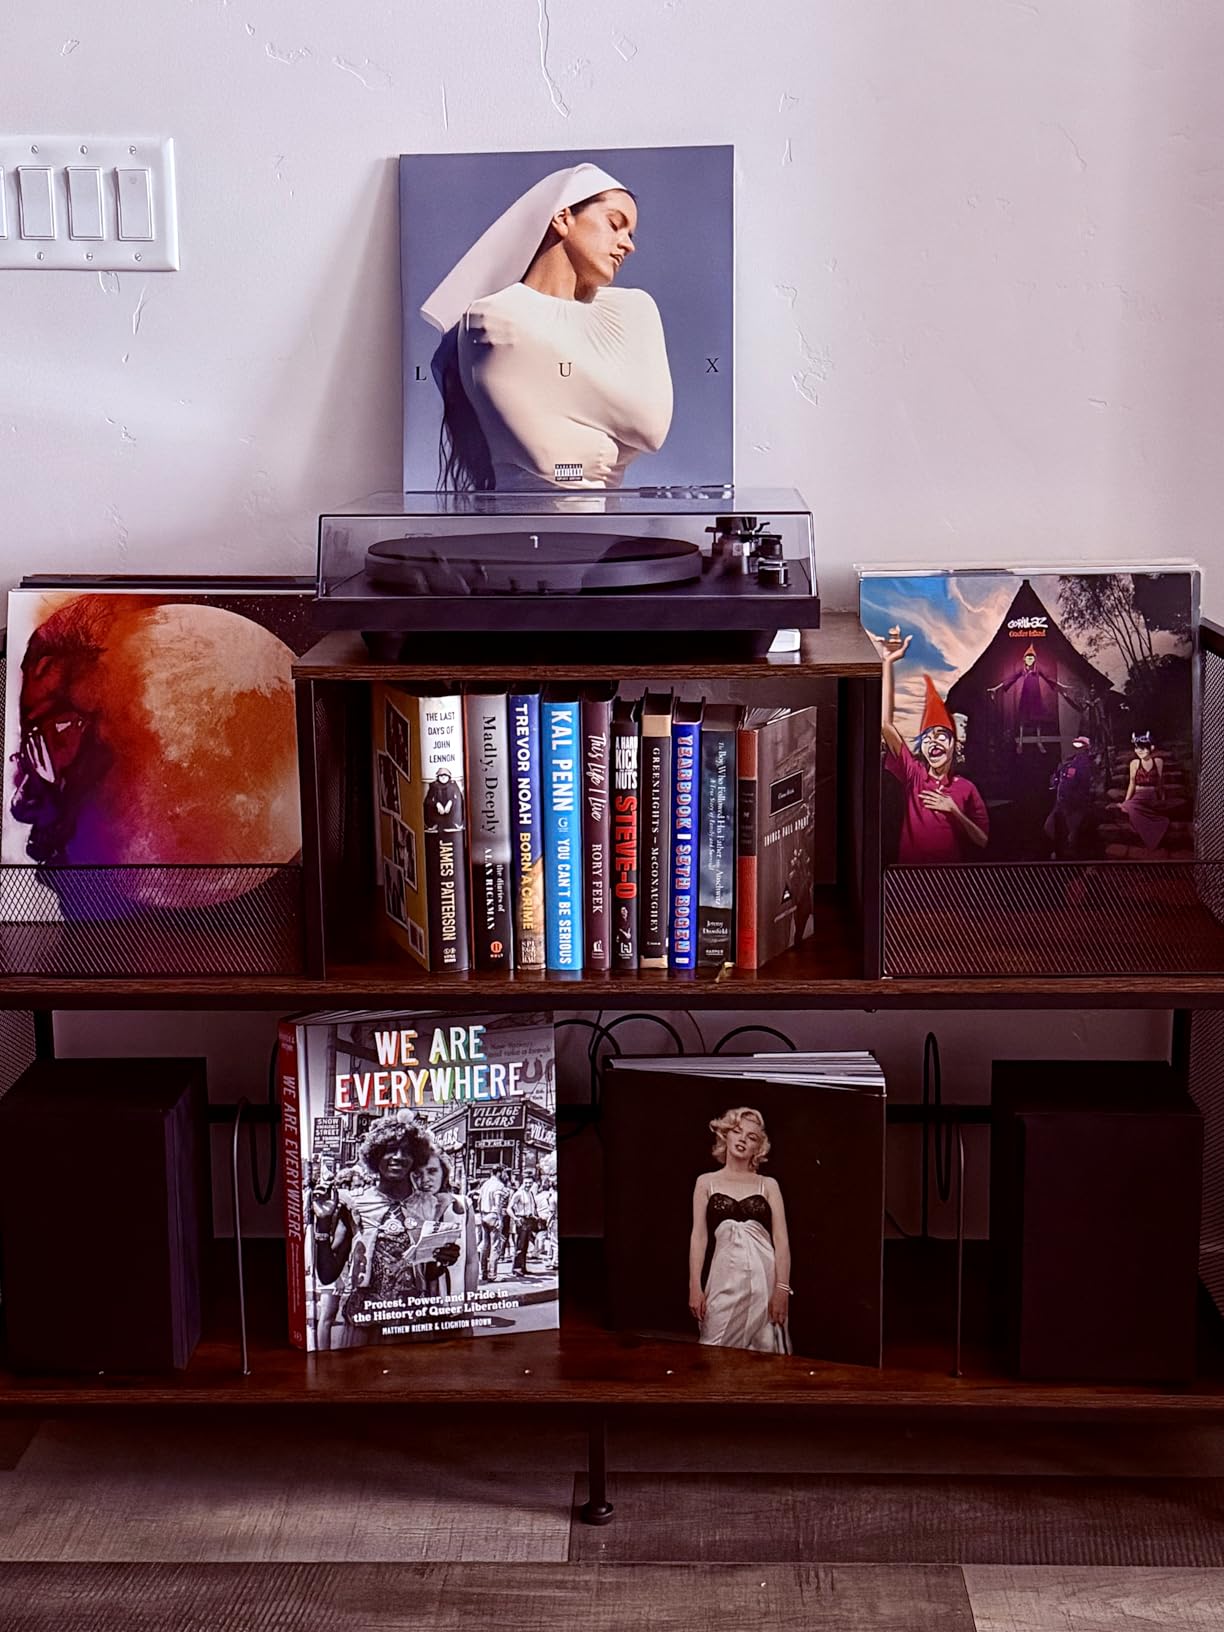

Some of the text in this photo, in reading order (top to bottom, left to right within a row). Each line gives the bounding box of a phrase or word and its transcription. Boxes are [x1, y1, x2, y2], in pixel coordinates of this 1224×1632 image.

[415, 358, 720, 381] L U X
[426, 711, 455, 721] THE LAST
[427, 725, 455, 736] DAYS OF
[551, 710, 573, 751] KAL
[429, 753, 455, 763] LENNON
[433, 740, 451, 750] JOHN
[587, 732, 607, 761] This
[615, 750, 638, 769] KICK
[480, 716, 500, 834] Madly, Deeply
[515, 703, 532, 825] TREVOR NOAH
[586, 762, 607, 786] Life
[552, 759, 574, 811] PENN
[615, 772, 638, 790] NUTS
[651, 747, 661, 833] GREENLIGHTS
[676, 734, 694, 829] YEARBOOK
[588, 797, 607, 822] Live
[717, 786, 727, 819] Followed
[439, 840, 454, 877] JAMES
[519, 832, 533, 872] BORN
[557, 838, 571, 860] YOU
[615, 795, 638, 899] STEVE-O
[716, 835, 725, 858] Father
[521, 875, 533, 885] A
[591, 844, 603, 914] RORY FEEK
[675, 844, 692, 890] SETH
[485, 879, 495, 930] RICKMAN
[650, 847, 659, 933] McCONAUGHEY
[440, 881, 457, 941] PATTERSON
[521, 889, 534, 930] CRIME
[558, 901, 572, 916] BE
[674, 894, 691, 953] ROGEN
[559, 919, 572, 965] SERIOUS
[374, 1029, 419, 1067] WE
[429, 1025, 486, 1064] ARE
[282, 1075, 297, 1099] WE
[334, 1062, 525, 1112] EVERYWHERE
[283, 1102, 299, 1135] ARE
[473, 1105, 521, 1117] VILLAGE
[474, 1116, 516, 1127] CIGARS
[285, 1140, 302, 1242] EVERYWHERE
[353, 1300, 519, 1323] the History of Queer Liberation
[364, 1289, 509, 1310] Protest, Power, and Pride in
[382, 1324, 410, 1336] MATTHEW
[441, 1320, 470, 1330] LEIGHTON
